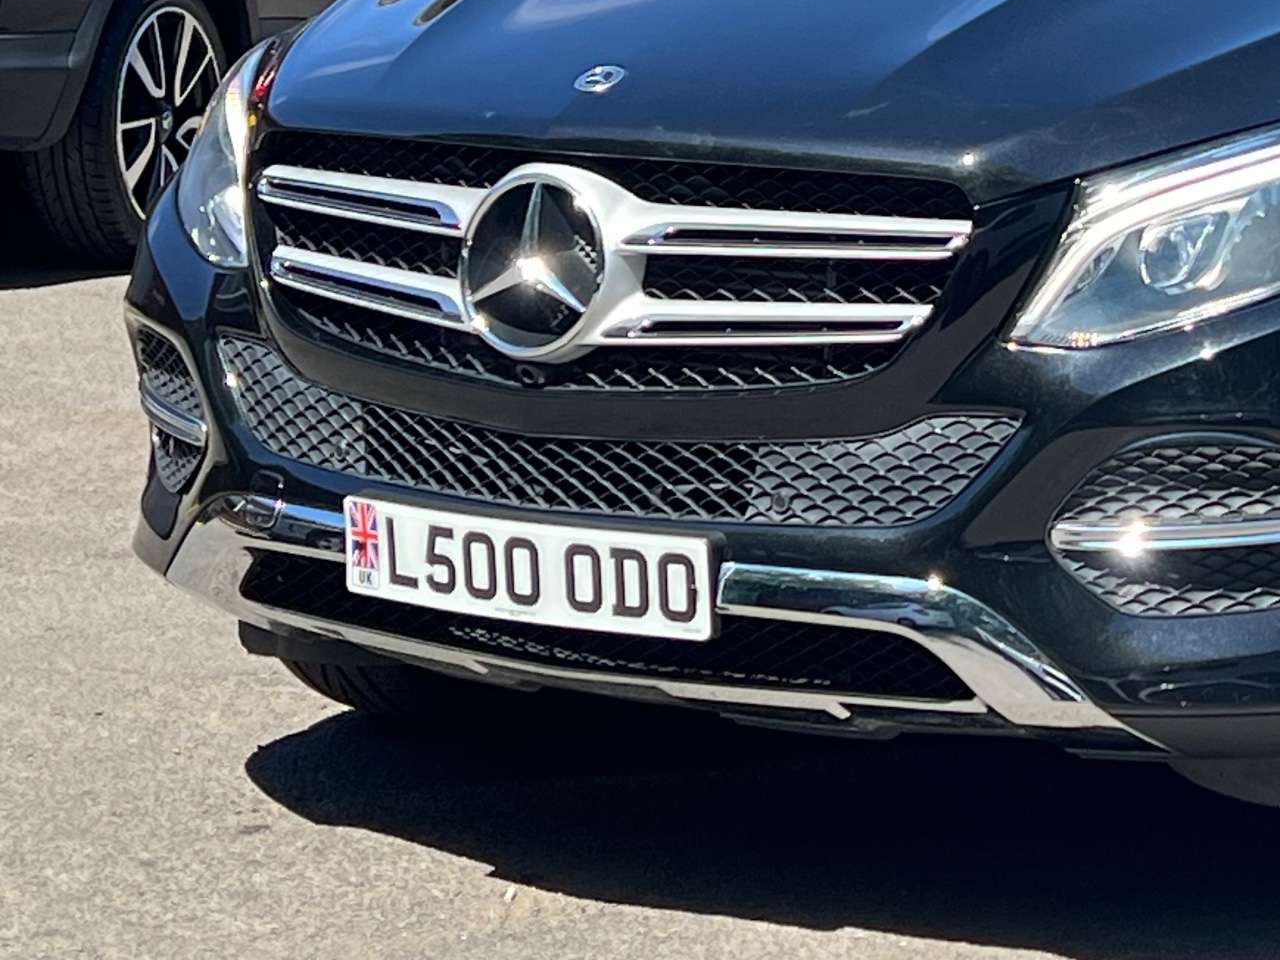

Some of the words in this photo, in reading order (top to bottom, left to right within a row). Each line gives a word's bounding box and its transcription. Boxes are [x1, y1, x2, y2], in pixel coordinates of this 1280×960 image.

[358, 570, 373, 585] UK
[385, 517, 540, 606] L500
[565, 543, 698, 622] ODO
